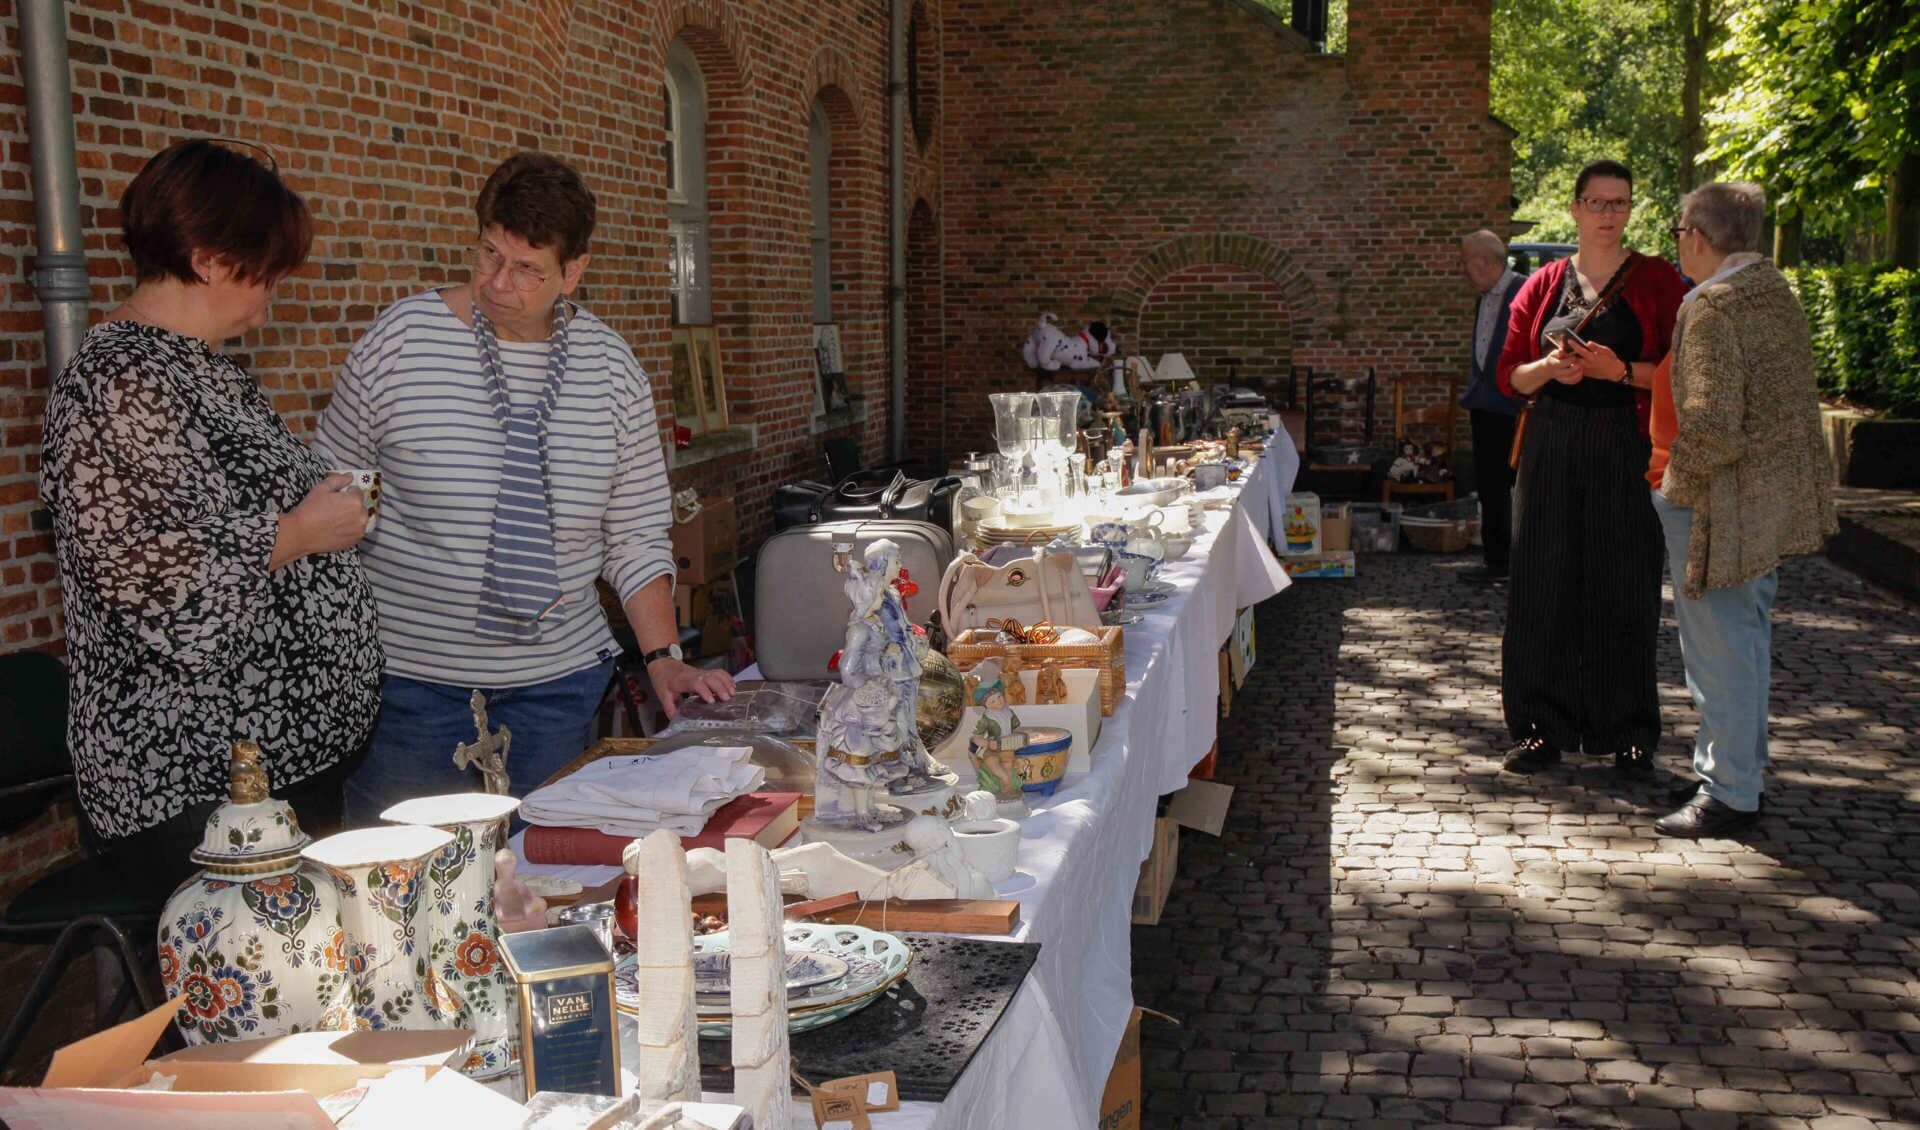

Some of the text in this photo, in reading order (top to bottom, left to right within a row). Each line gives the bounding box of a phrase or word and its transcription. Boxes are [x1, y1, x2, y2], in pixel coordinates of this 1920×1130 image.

[557, 995, 584, 1006] VAN
[552, 1003, 590, 1015] NELLE
[1099, 1099, 1133, 1130] ingen
